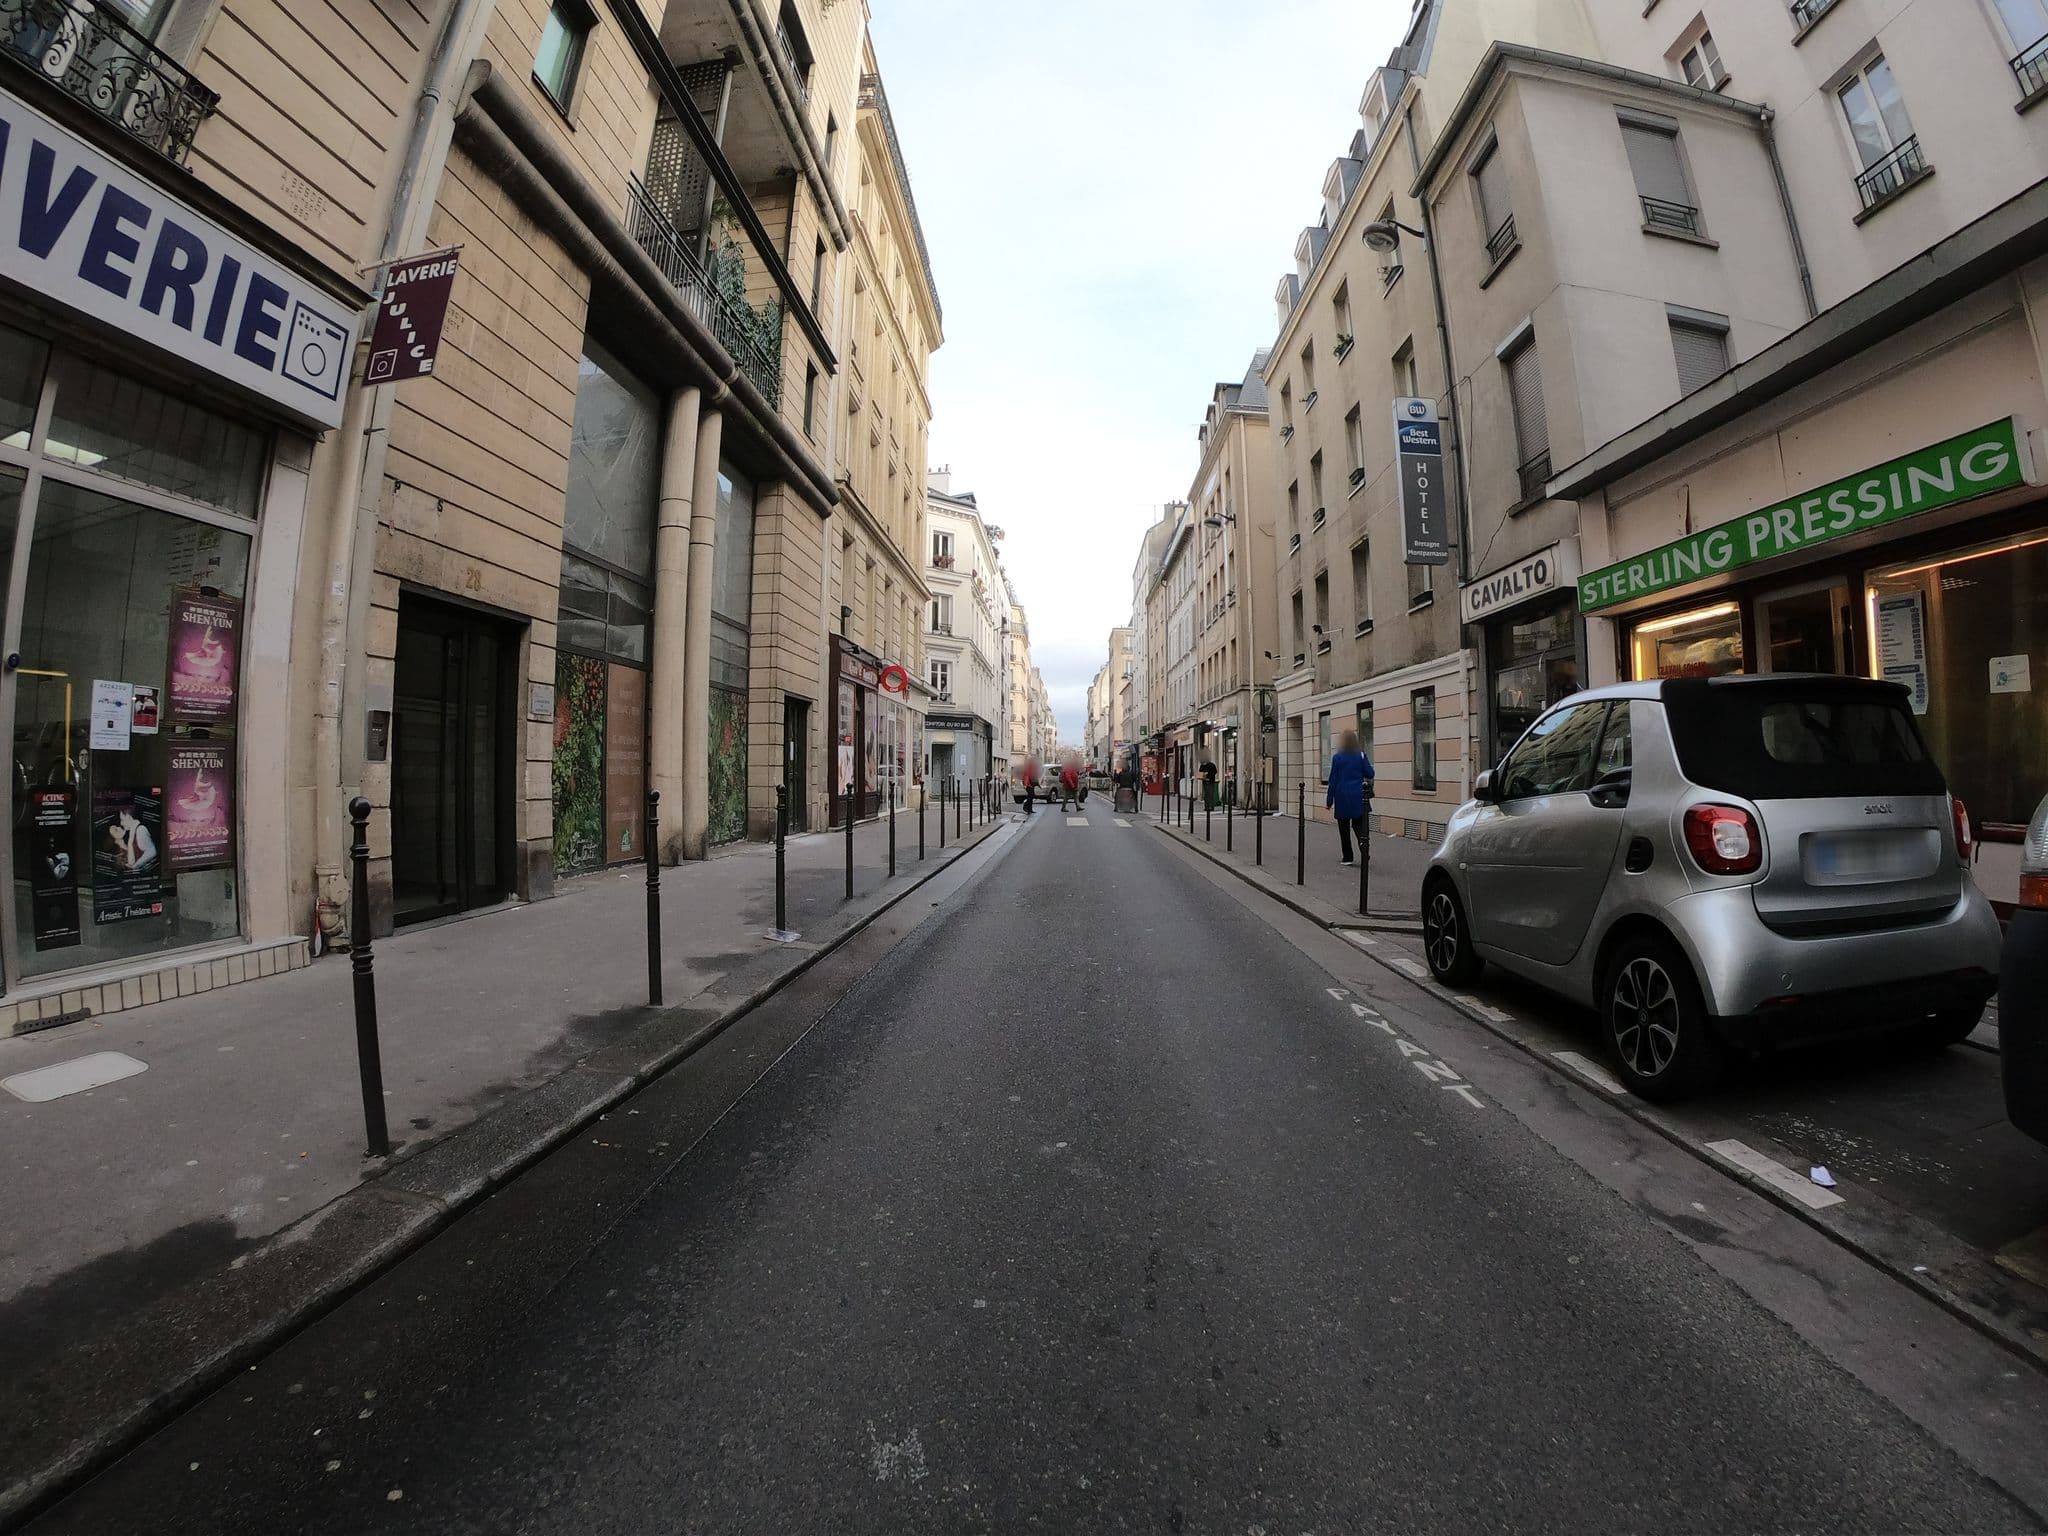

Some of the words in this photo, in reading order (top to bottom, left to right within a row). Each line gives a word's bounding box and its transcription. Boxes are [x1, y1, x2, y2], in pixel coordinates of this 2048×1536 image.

[386, 259, 457, 288] LAVERIE
[383, 291, 434, 373] JULICE
[1408, 405, 1425, 416] BW
[1402, 435, 1437, 446] Western
[1409, 428, 1429, 438] Best
[1416, 461, 1430, 535] HOTEL
[1582, 530, 1734, 606] STERLING
[1747, 440, 2011, 558] PRESSING
[465, 566, 482, 592] 28
[1471, 559, 1548, 610] CAVALTO
[182, 611, 211, 626] SHEN
[211, 617, 233, 630] YUN
[172, 758, 201, 769] SHEN
[202, 758, 224, 769] YUN
[1325, 987, 1486, 1109] PAYANT
